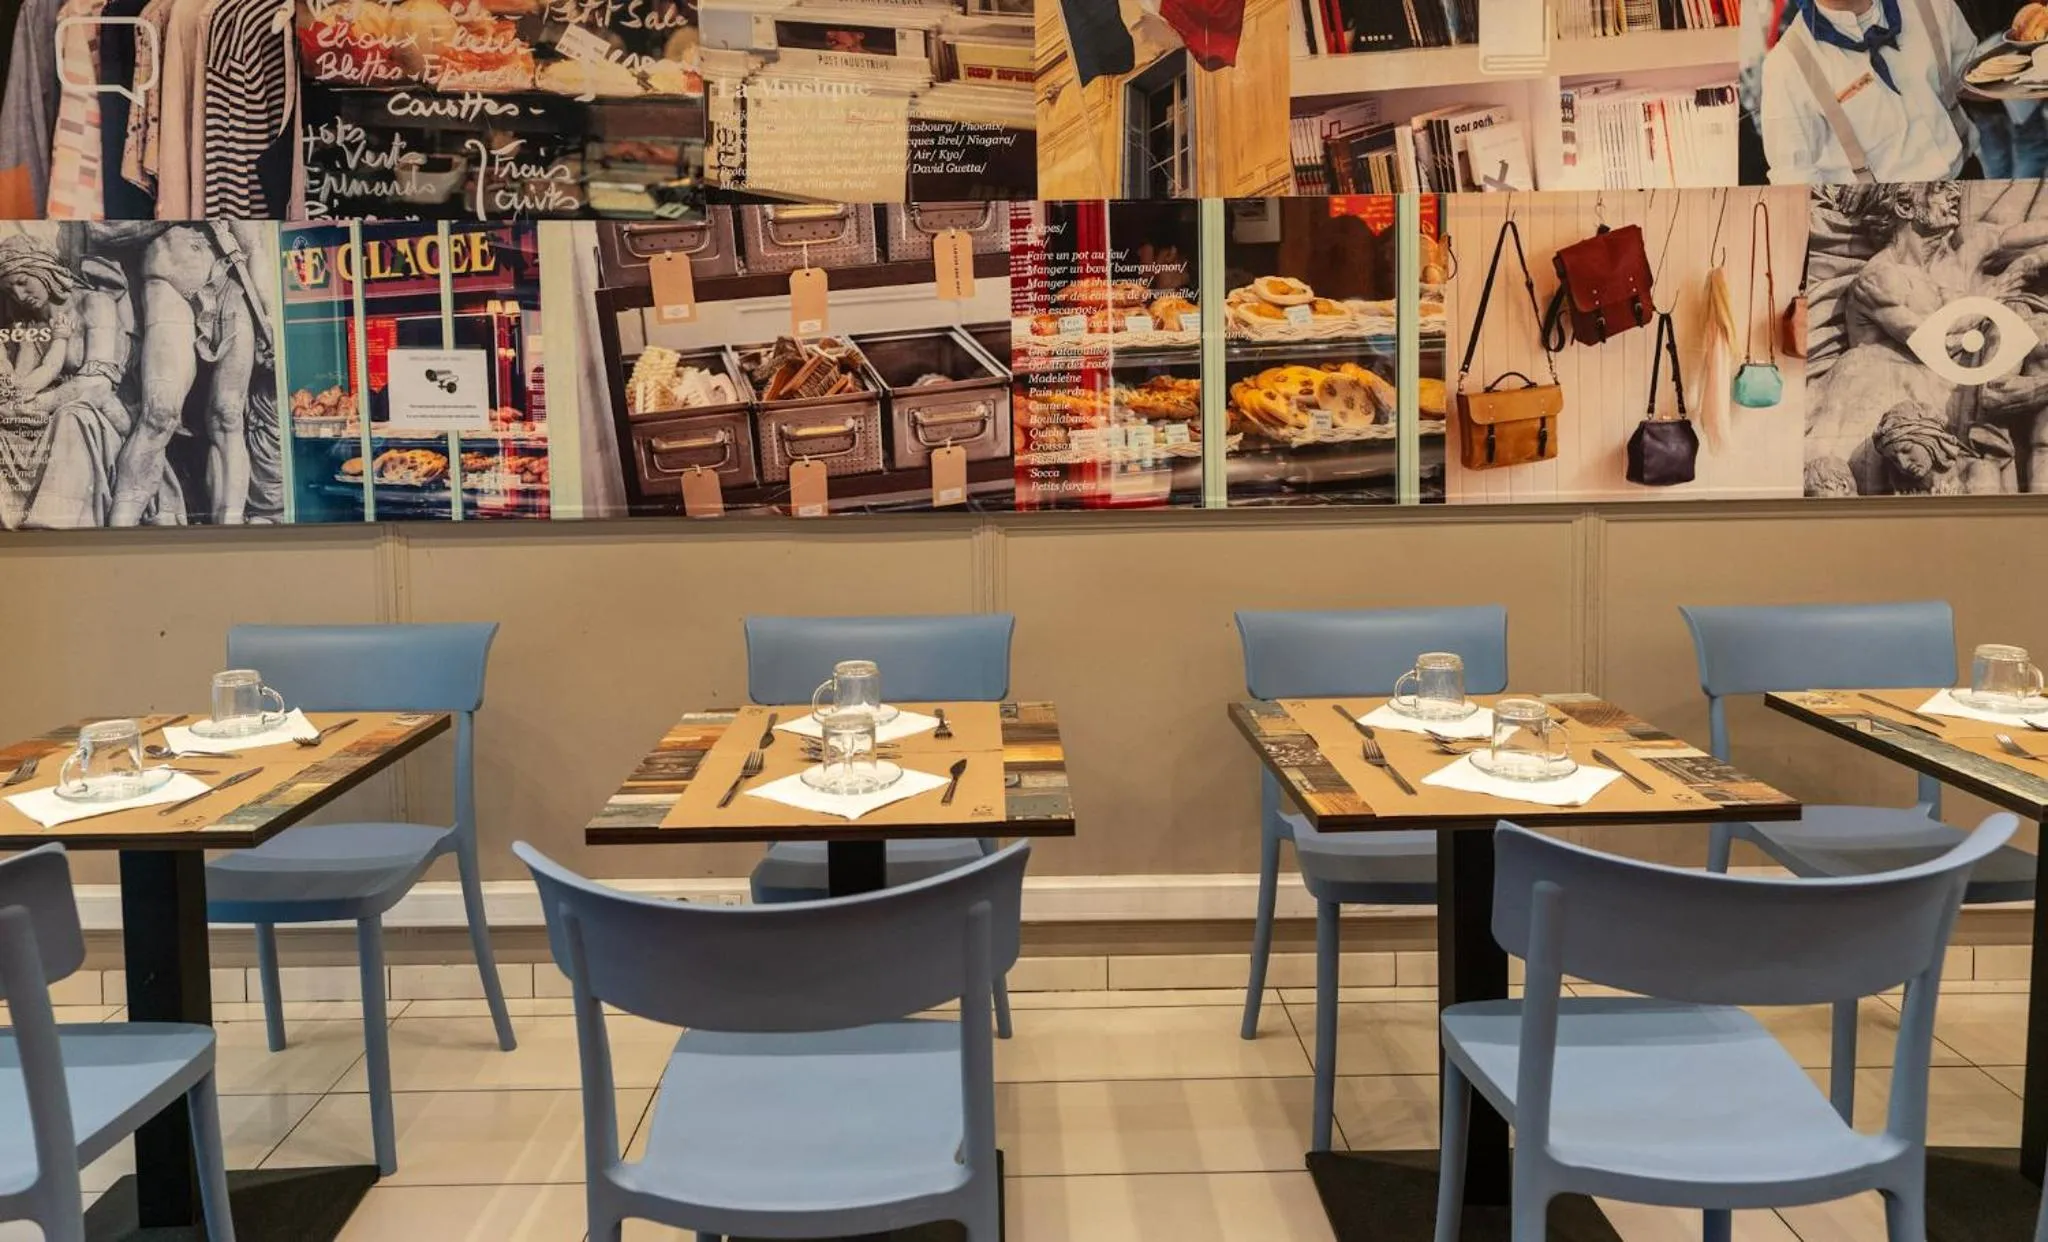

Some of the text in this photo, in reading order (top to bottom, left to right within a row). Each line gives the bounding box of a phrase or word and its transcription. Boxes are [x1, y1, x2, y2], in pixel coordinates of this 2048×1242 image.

[960, 121, 1007, 133] Phoenix/
[937, 135, 965, 147] Brel/
[966, 134, 1017, 147] Niagara/
[938, 149, 966, 162] Kyo/
[912, 162, 945, 174] David
[945, 162, 987, 175] Guetta/
[1027, 251, 1054, 261] Faire
[1056, 252, 1070, 261] un
[1071, 251, 1089, 263] pot
[1027, 264, 1068, 275] Manger
[1027, 278, 1068, 289] Manger
[1027, 292, 1070, 304] Manger
[0, 321, 52, 342] sées
[1028, 373, 1082, 384] Madeleine
[1029, 387, 1052, 397] Pain
[1030, 467, 1061, 478] Socca
